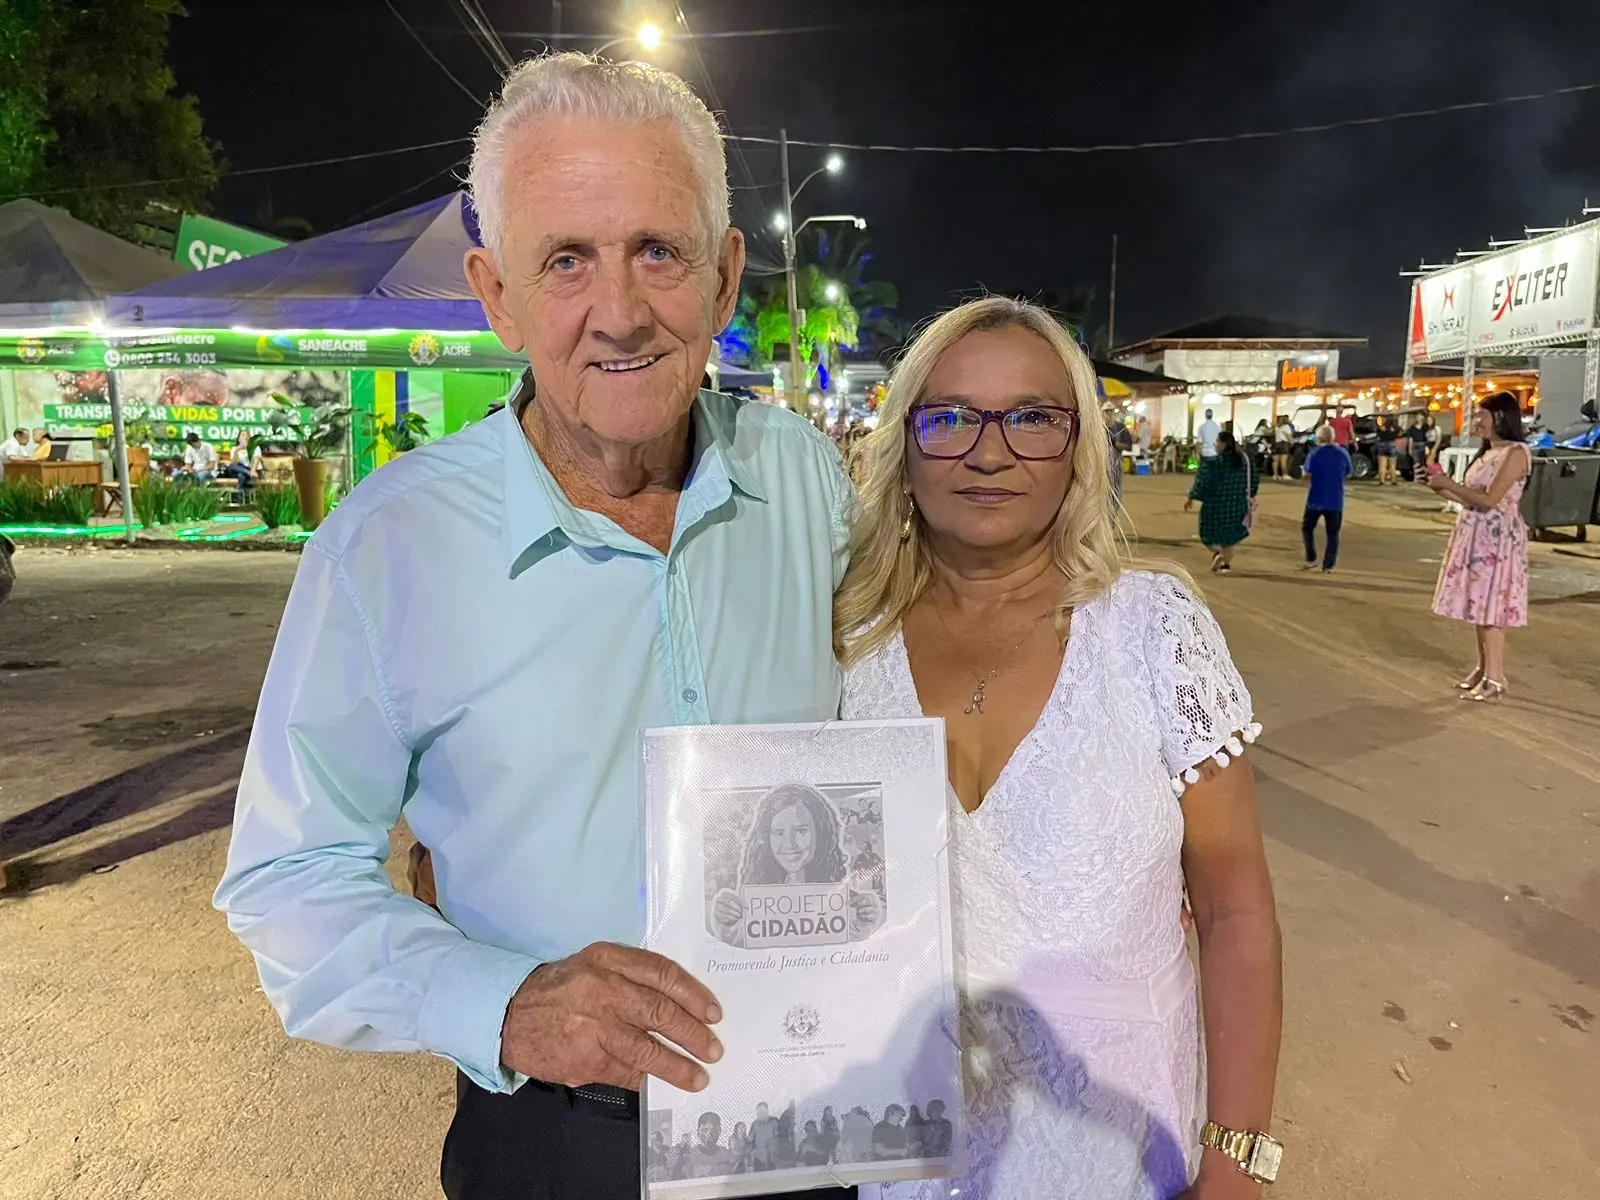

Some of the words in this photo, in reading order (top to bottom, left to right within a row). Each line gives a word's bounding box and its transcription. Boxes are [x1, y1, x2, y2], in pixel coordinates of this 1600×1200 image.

[188, 239, 249, 272] SE
[1491, 262, 1568, 323] EXCITER
[297, 339, 368, 352] SANEACRE
[442, 344, 472, 357] ACRE
[184, 353, 217, 365] 3003
[55, 406, 168, 420] TRANSFRMAR
[170, 407, 219, 421] VIDAS
[222, 408, 256, 422] POR
[207, 425, 298, 441] QUAIDADE
[750, 893, 844, 916] PROJETO
[746, 912, 847, 938] CIDADÃO
[706, 956, 777, 973] Promovendo
[778, 954, 817, 972] Justiça
[820, 955, 827, 964] e
[830, 950, 891, 966] Cidadania
